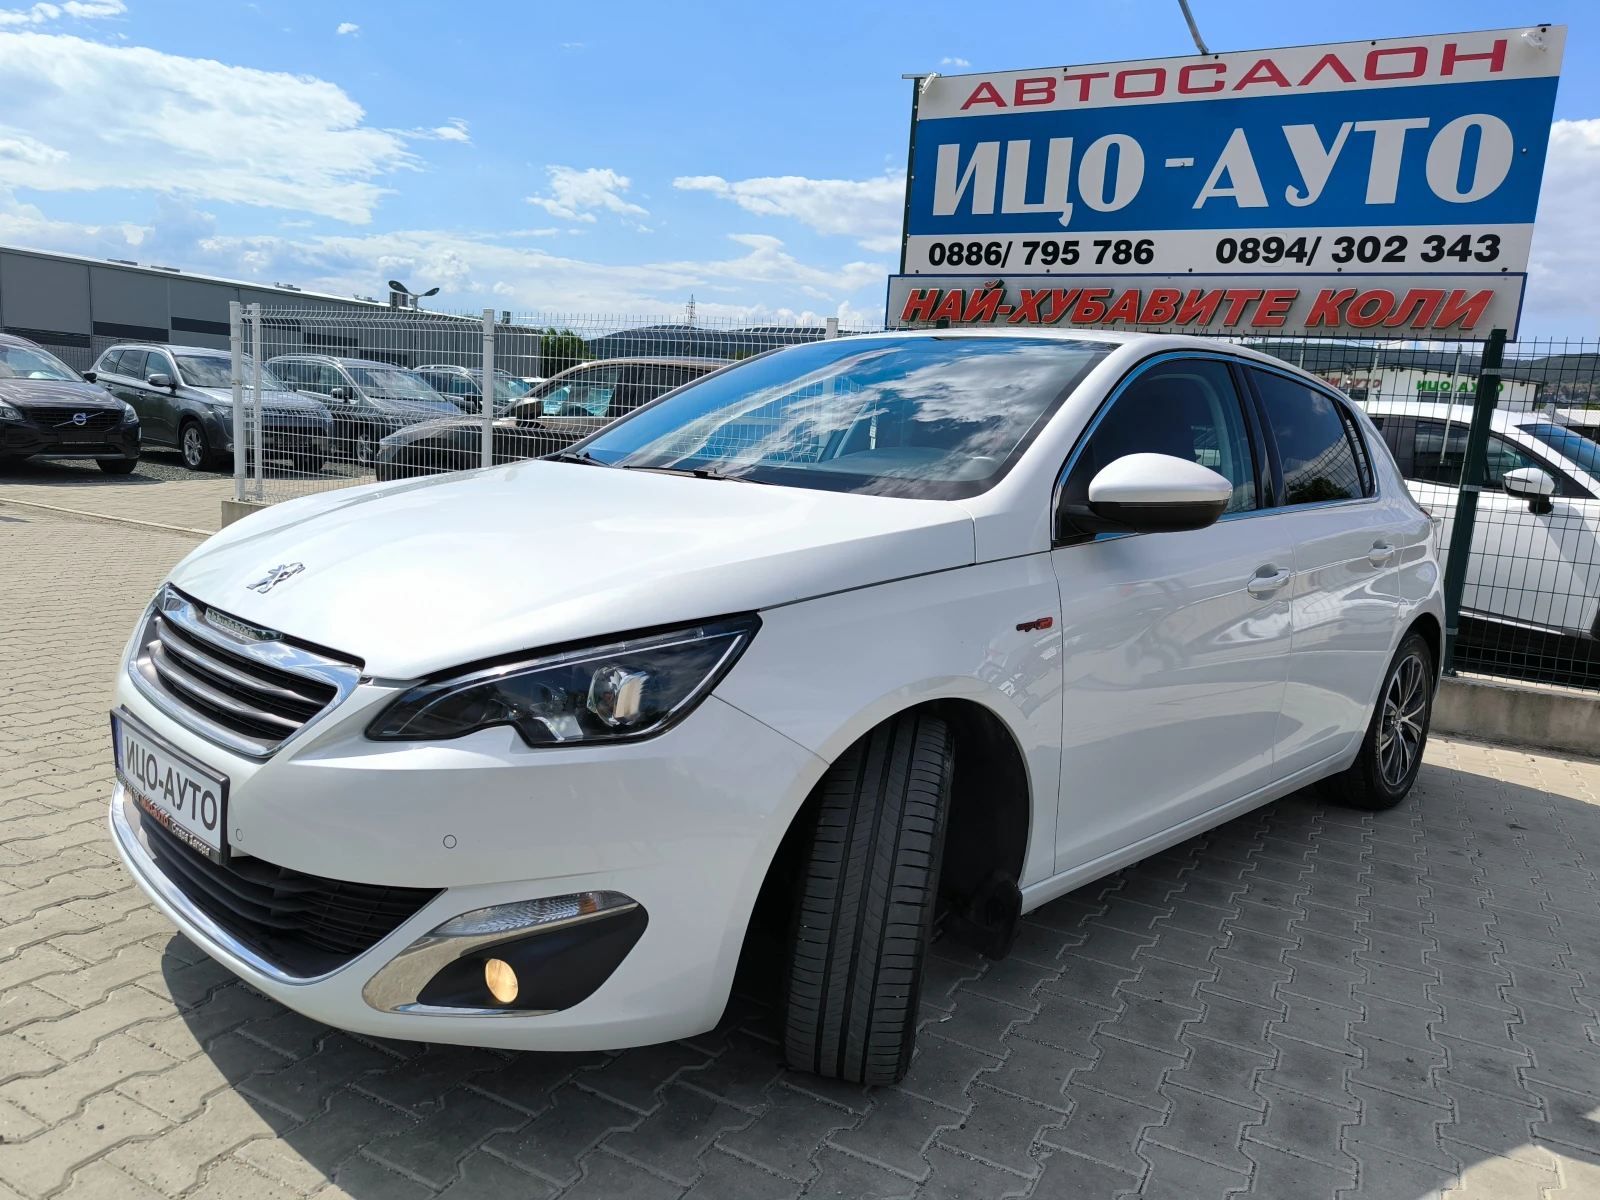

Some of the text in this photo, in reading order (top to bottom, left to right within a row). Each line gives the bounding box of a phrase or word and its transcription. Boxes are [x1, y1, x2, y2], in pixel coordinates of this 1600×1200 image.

[960, 39, 1508, 110] АВТОСАЛОН
[928, 239, 1155, 268] 0886/ 795 786
[1215, 234, 1501, 266] 0894/ 302 343
[901, 279, 1496, 329] НАЙ-ХУБАВИТЕ КОЛИ
[125, 735, 218, 832] ИЦО-АУТО
